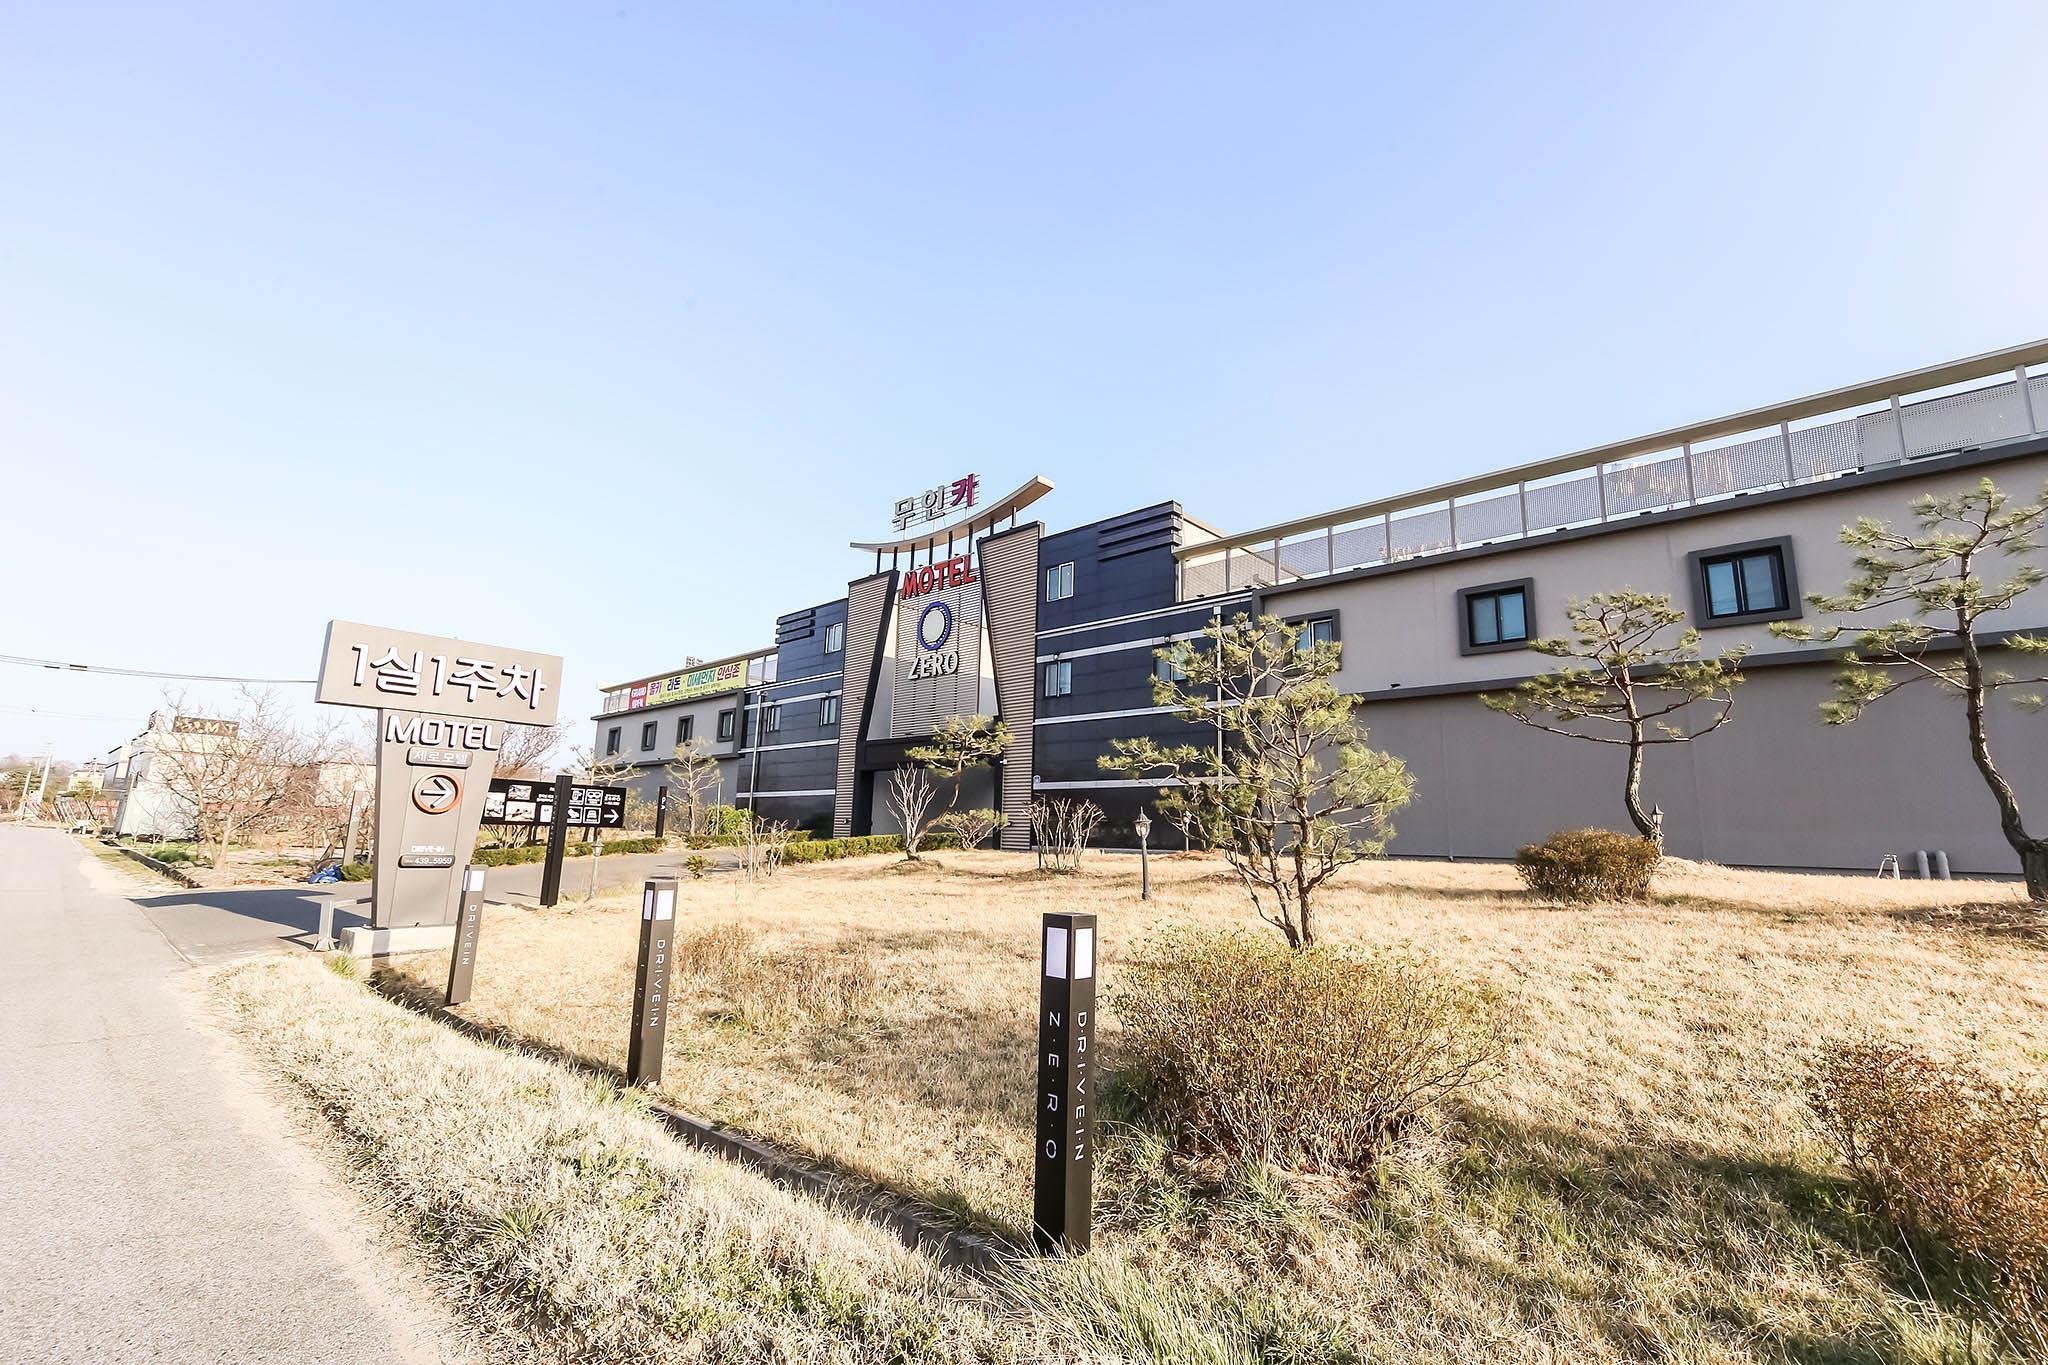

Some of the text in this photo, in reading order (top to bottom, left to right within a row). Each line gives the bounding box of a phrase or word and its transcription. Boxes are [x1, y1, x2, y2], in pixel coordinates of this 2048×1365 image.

[892, 473, 980, 530] 무인카
[900, 554, 976, 600] MOTEL
[687, 669, 717, 688] 미세먼지
[716, 663, 741, 681] 안심존
[908, 651, 959, 681] ZERO
[384, 714, 501, 751] MOTEL
